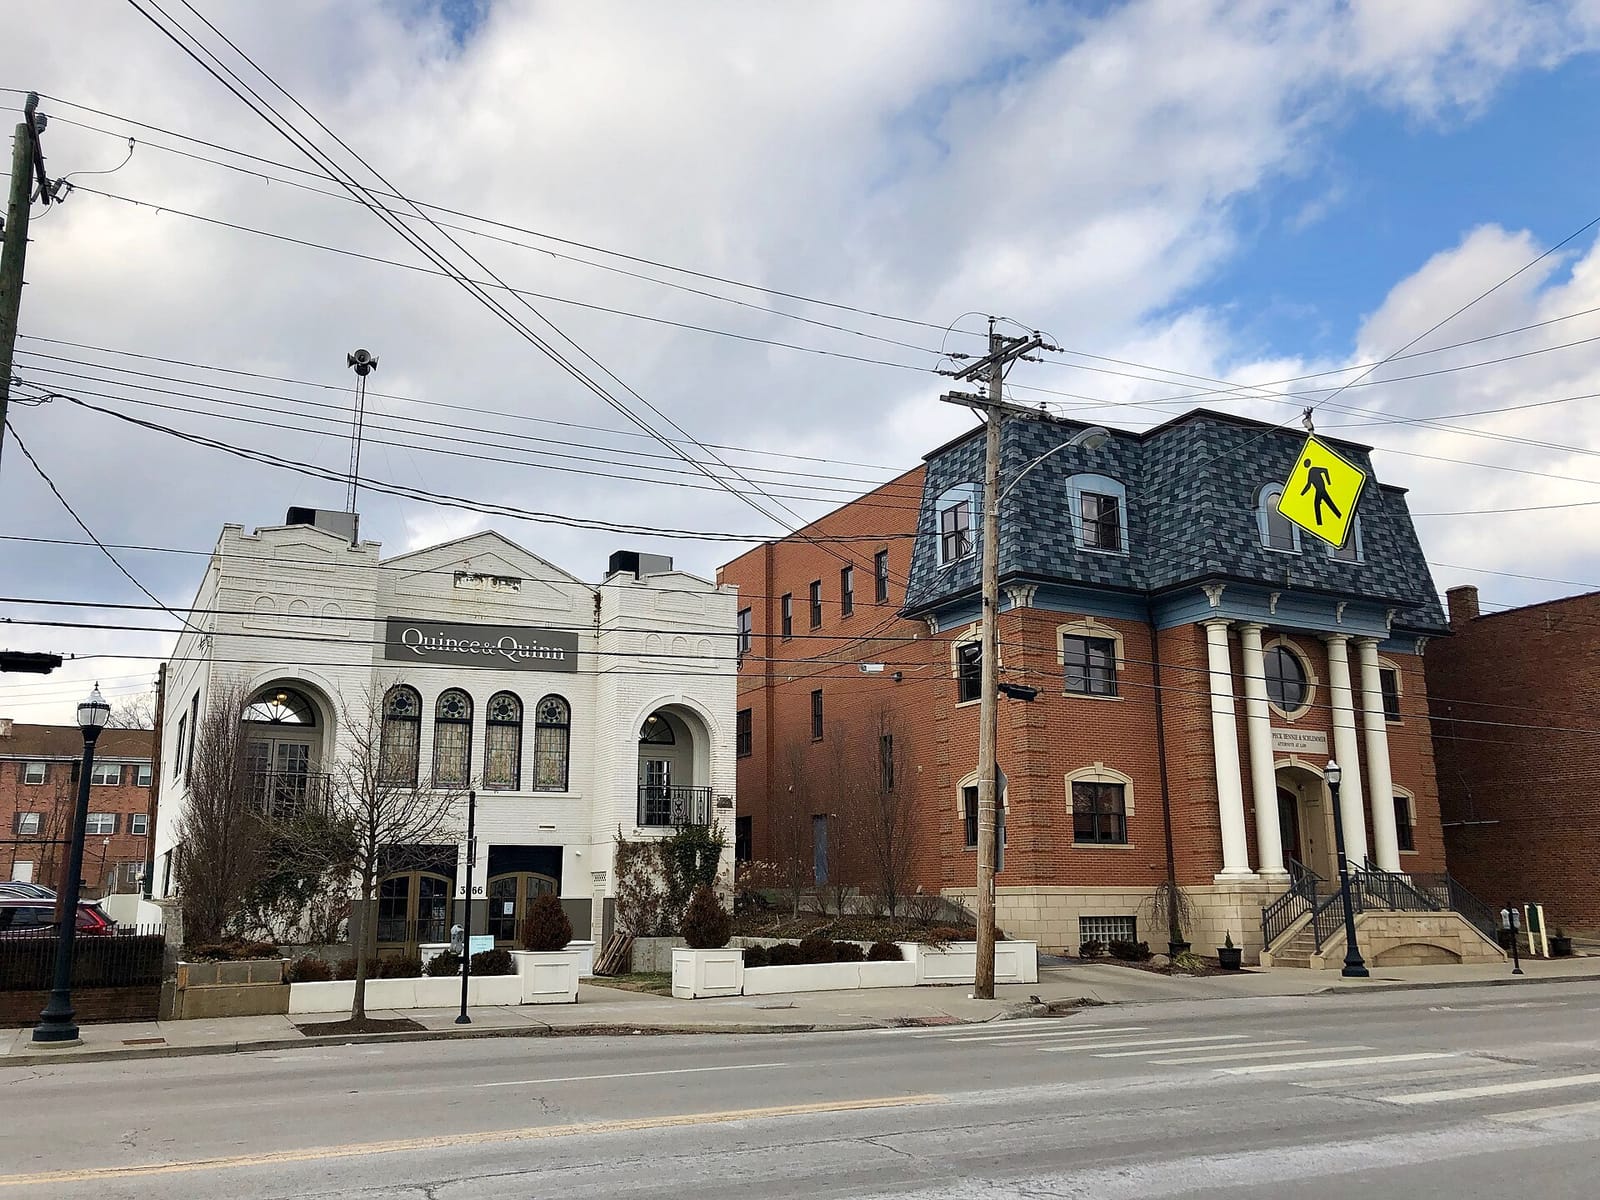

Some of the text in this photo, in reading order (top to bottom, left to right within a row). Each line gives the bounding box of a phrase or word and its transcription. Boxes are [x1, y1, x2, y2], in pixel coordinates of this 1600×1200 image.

[401, 627, 481, 655] Quince
[498, 636, 565, 662] Quinn
[460, 886, 483, 895] 366
